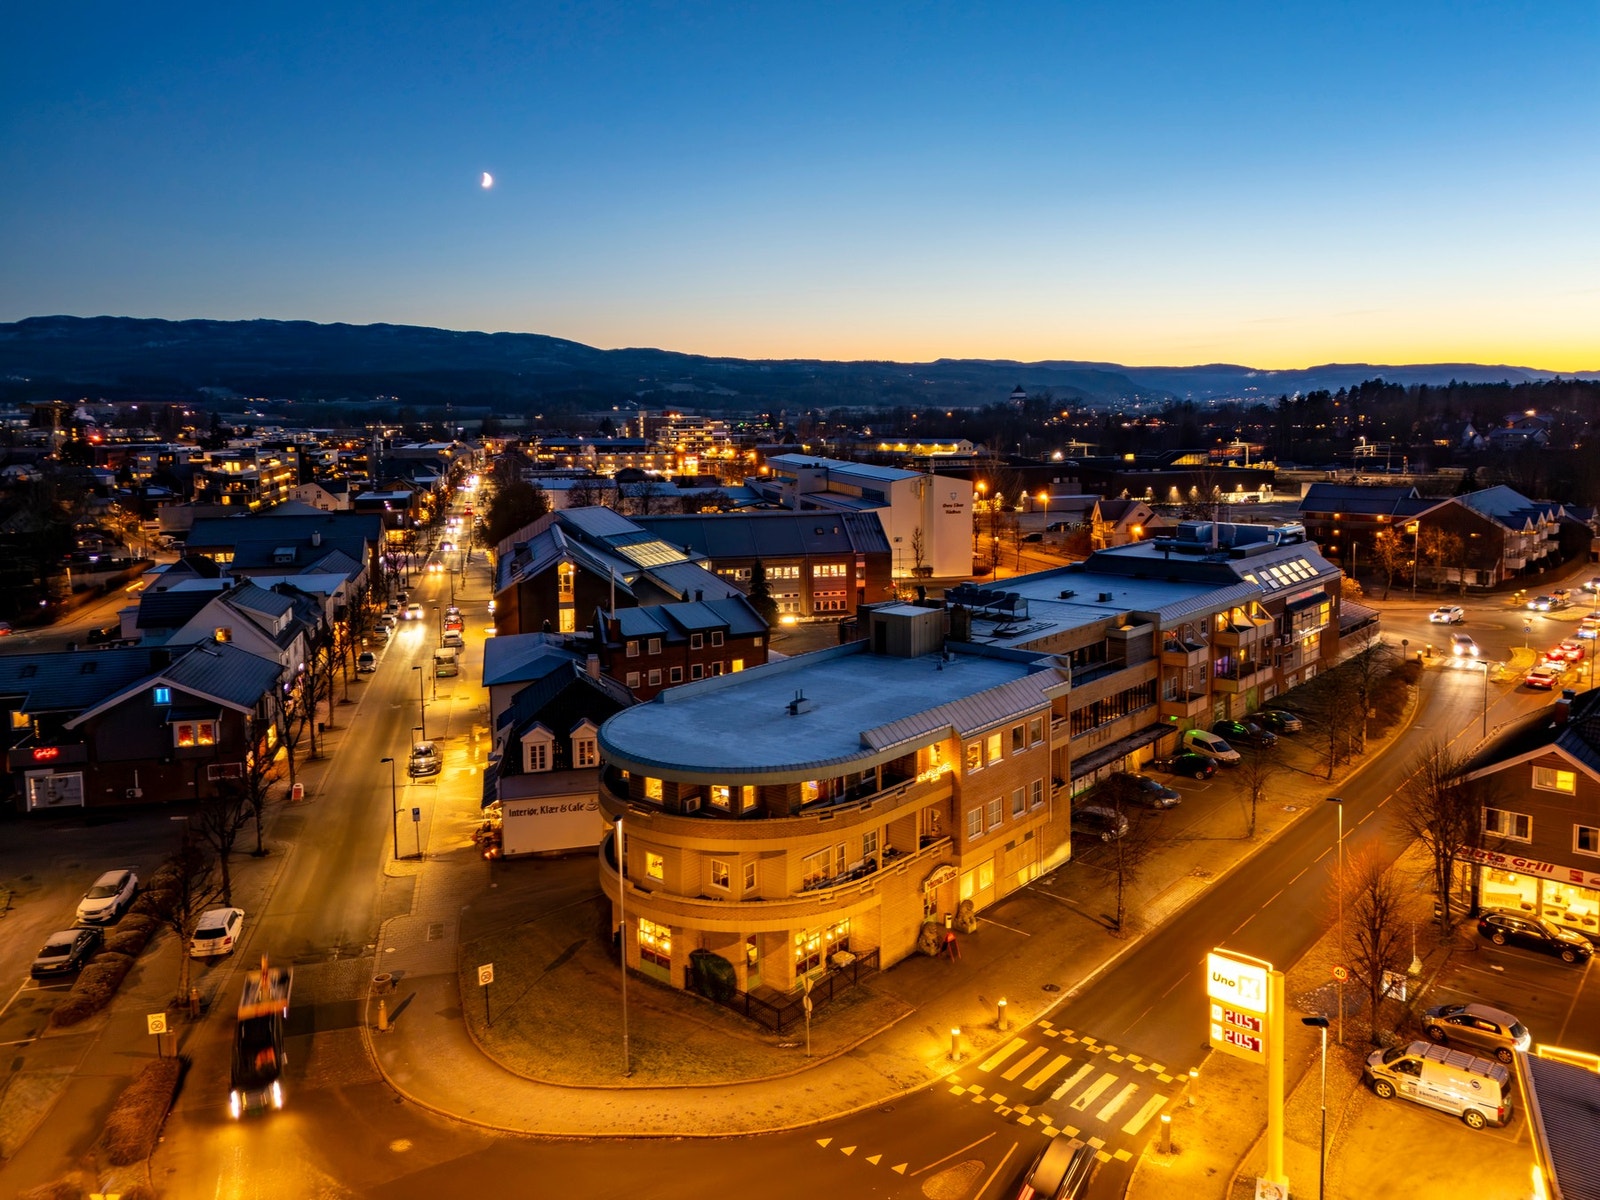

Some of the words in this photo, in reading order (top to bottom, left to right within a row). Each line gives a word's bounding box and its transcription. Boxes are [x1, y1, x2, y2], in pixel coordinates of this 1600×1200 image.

[508, 807, 539, 818] Interiør,
[540, 805, 558, 815] Klær
[559, 804, 567, 813] &
[1511, 858, 1555, 873] Grill
[1212, 972, 1236, 987] Uno
[1335, 969, 1346, 978] 40
